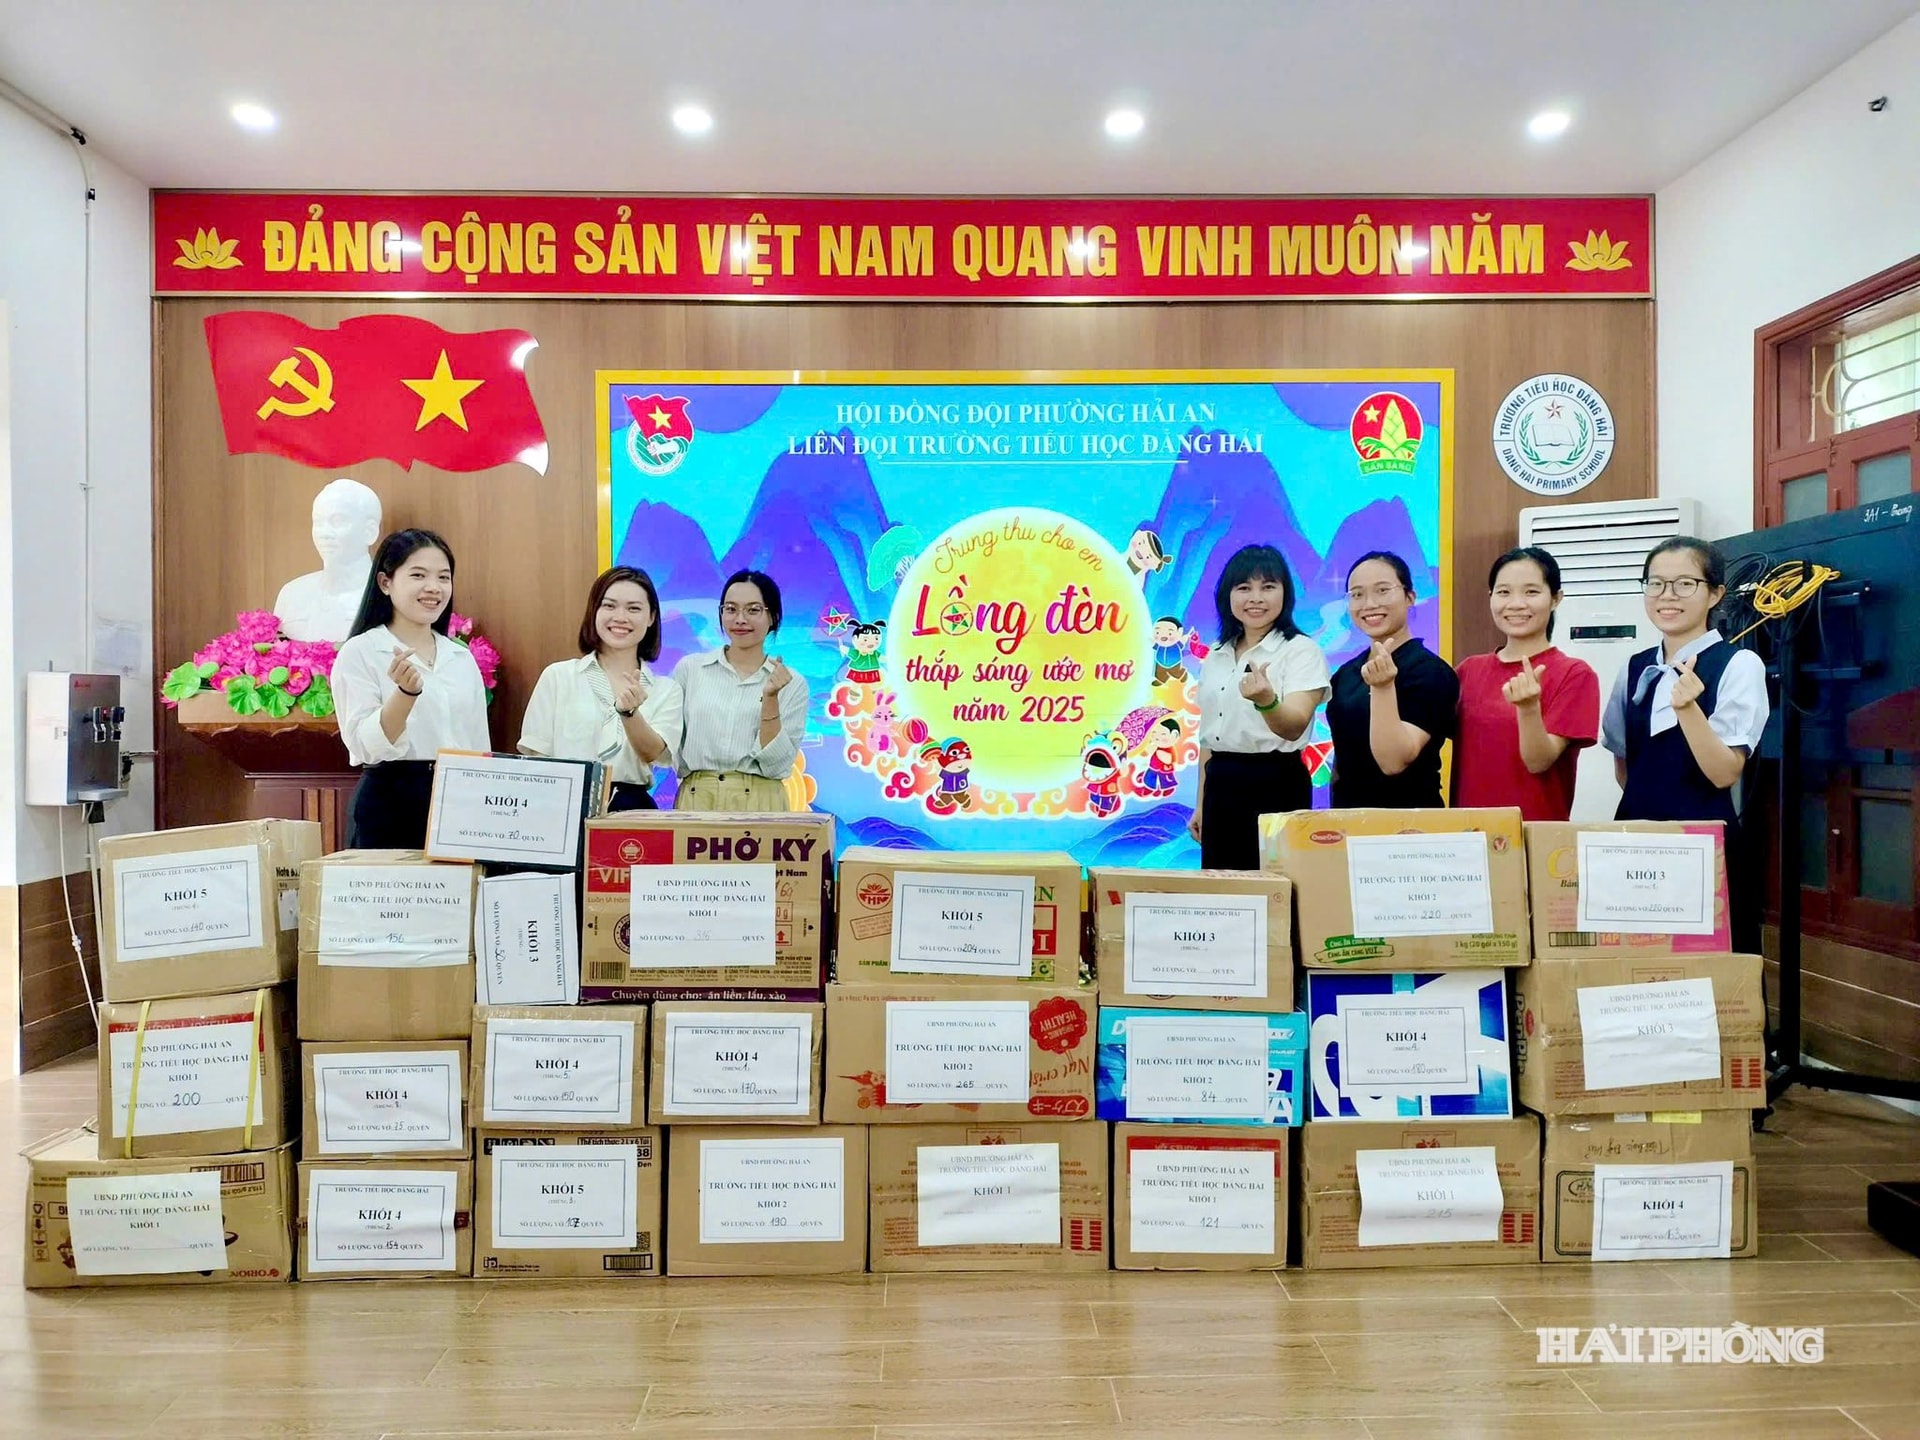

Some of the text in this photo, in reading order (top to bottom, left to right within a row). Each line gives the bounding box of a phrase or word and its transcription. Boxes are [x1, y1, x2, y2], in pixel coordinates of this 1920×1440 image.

[263, 204, 1544, 285] ĐẢNG CỘNG SẢN VIỆT NAM QUANG VINH MUÔN NĂM
[836, 398, 1214, 430] HỘI ĐỒNG ĐỘI PHƯỜNG HẢI AN
[788, 430, 846, 455] LIÊN
[853, 433, 897, 460] ĐỘI
[903, 430, 1010, 455] TRƯỜNG
[1016, 428, 1075, 455] TIỂU
[1083, 434, 1135, 460] HỌC
[1219, 427, 1263, 454] HẢI
[1503, 448, 1605, 489] DANG HAI PRIMARY SCHOOL
[935, 516, 1102, 573] Trung thu cho em
[912, 575, 1128, 655] Lồng đèn
[906, 650, 1134, 692] thắp sáng ước mơ
[953, 696, 1085, 722] năm 2025
[522, 799, 528, 808] 4
[687, 831, 817, 862] PHỞ KÝ
[786, 869, 808, 877] Nam
[1659, 871, 1666, 879] 3
[201, 889, 207, 899] 5
[1432, 893, 1437, 901] 2
[977, 912, 983, 921] 5
[1209, 933, 1215, 942] 3
[612, 990, 650, 1000] Chuyên
[652, 990, 678, 1000] dùng
[680, 990, 702, 1000] cho:
[768, 991, 786, 1000] xào
[1039, 1010, 1077, 1033] HEALTHY
[1668, 1024, 1674, 1033] 3
[1421, 1033, 1426, 1041] 4
[752, 1052, 758, 1061] 4
[572, 1060, 579, 1069] 4
[968, 1063, 973, 1071] 2
[194, 1073, 198, 1081] 1
[956, 1081, 974, 1089] 265
[173, 1092, 200, 1106] 200
[401, 1091, 408, 1099] 4
[1201, 1091, 1216, 1103] 84
[578, 1185, 584, 1194] 5
[1450, 1190, 1454, 1200] 1
[1678, 1201, 1684, 1209] 4
[395, 1210, 401, 1220] 4
[1200, 1217, 1219, 1228] 121
